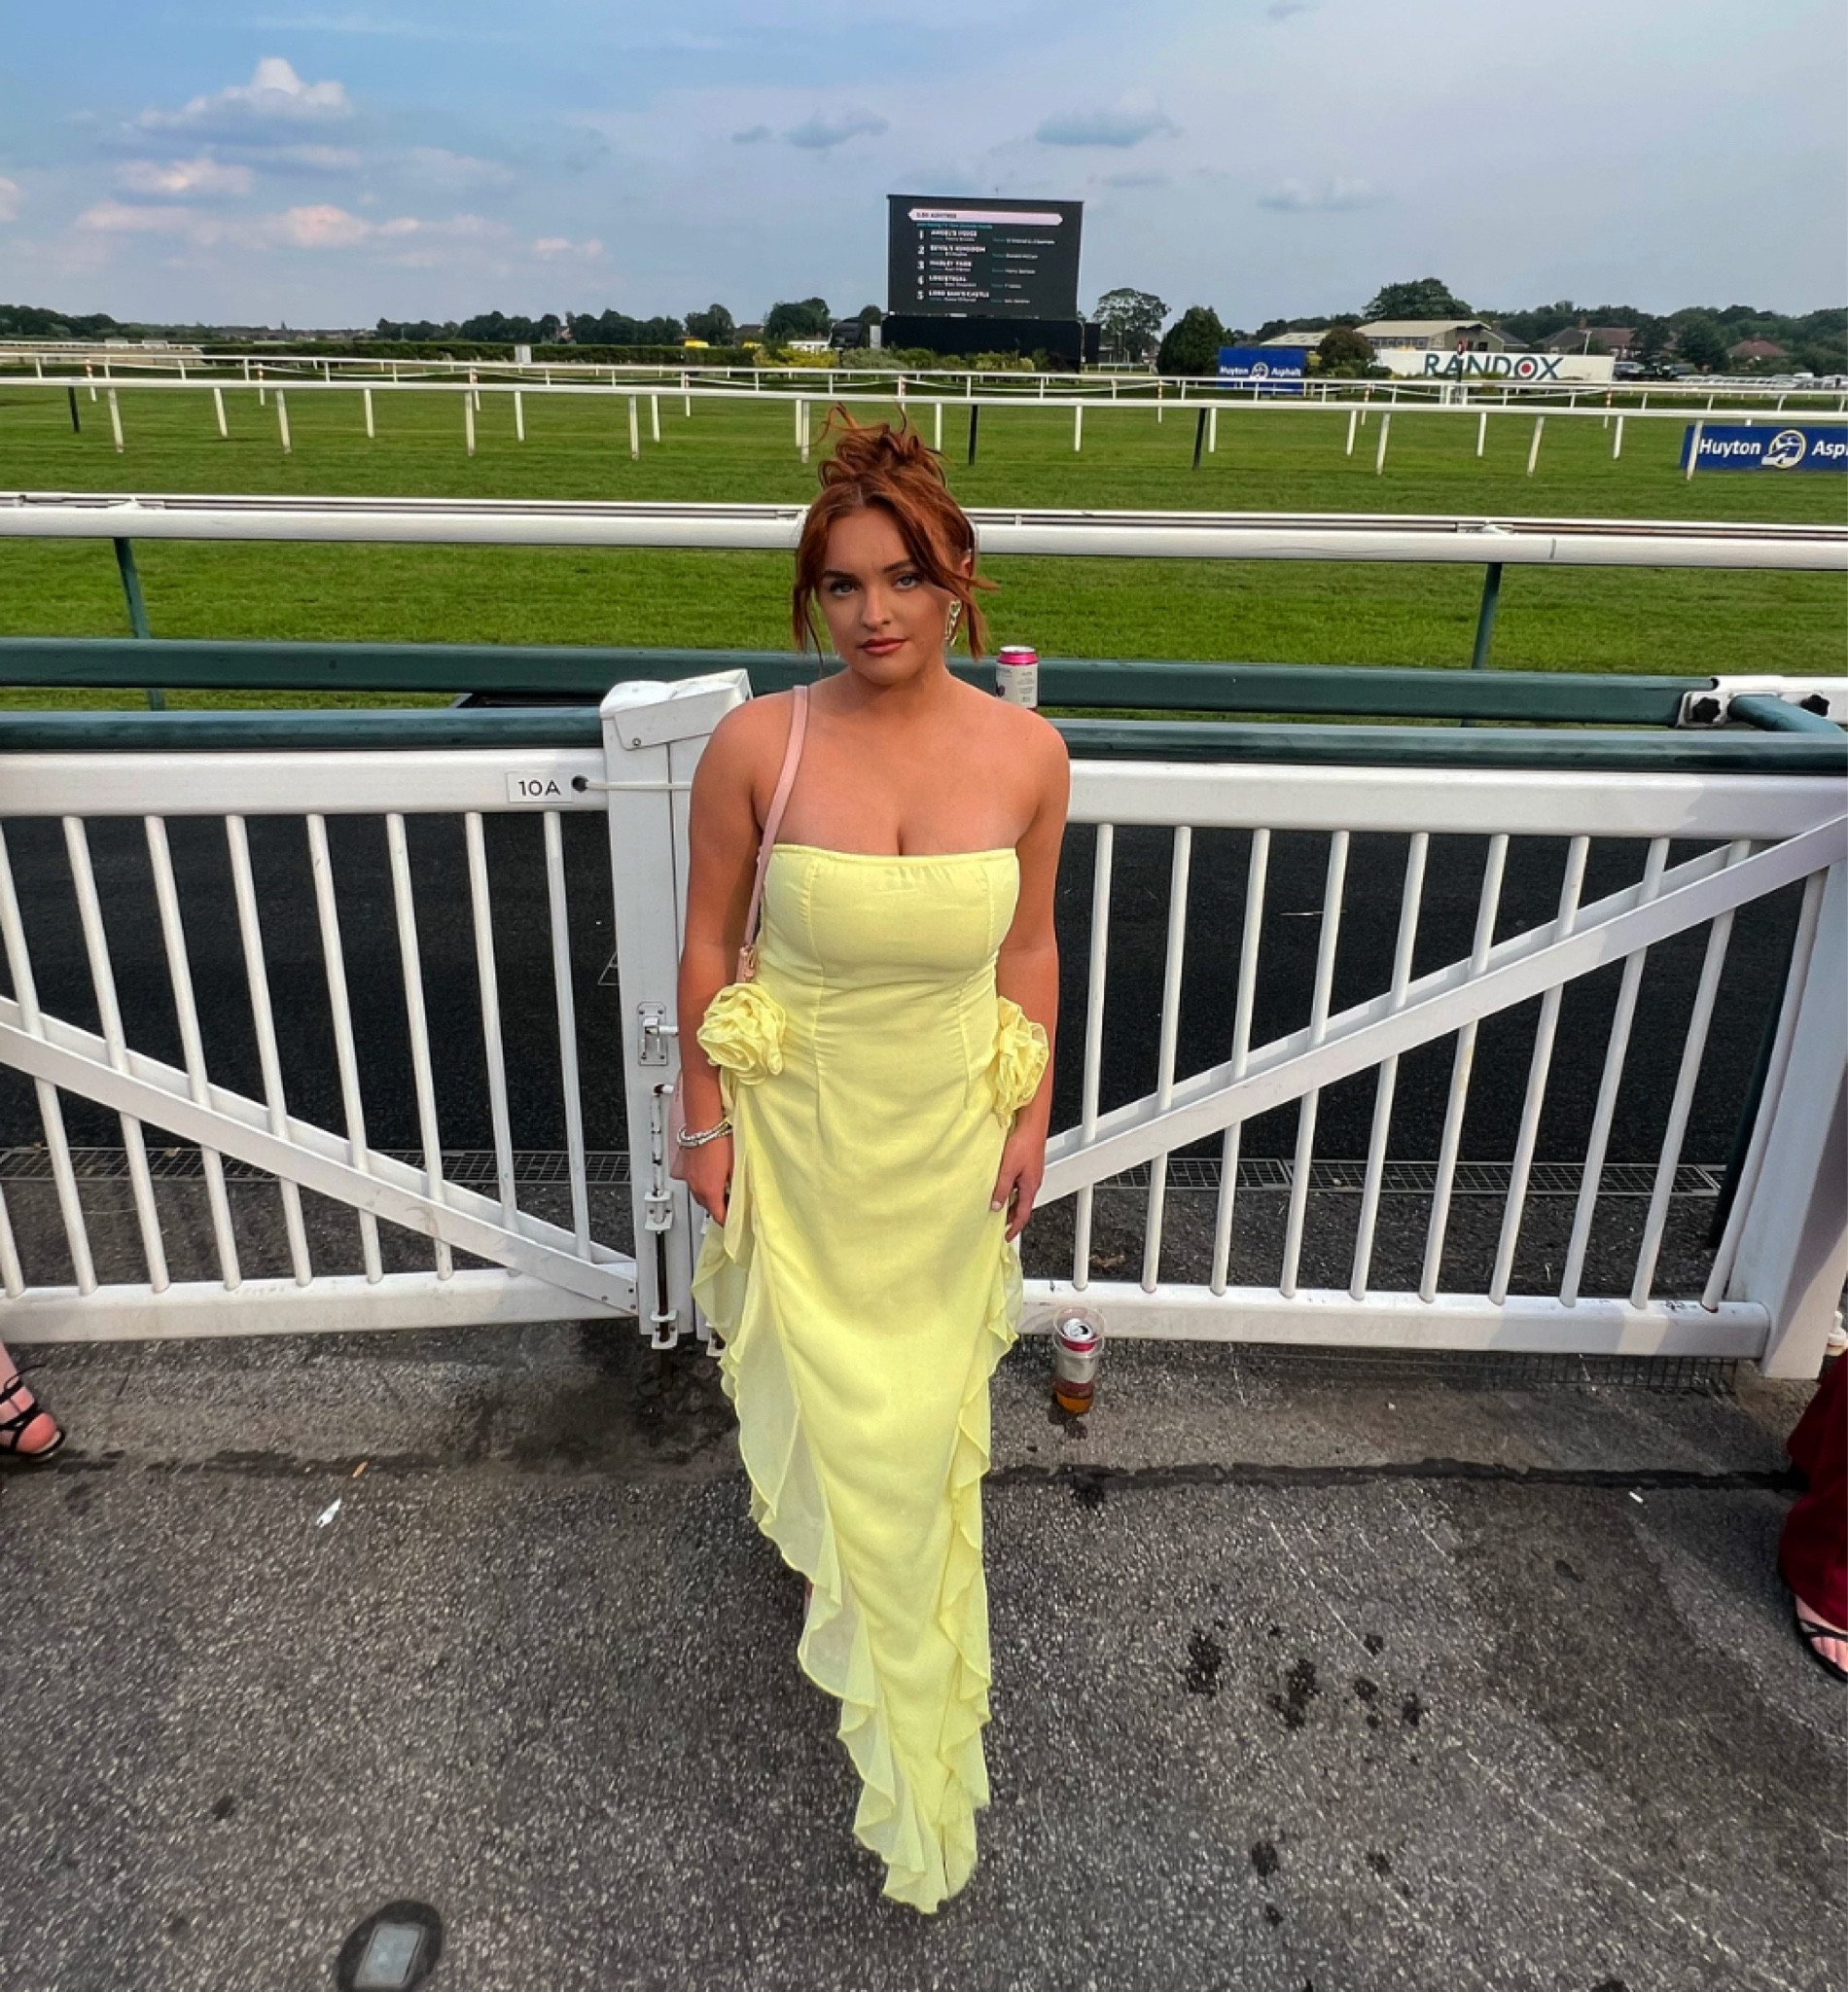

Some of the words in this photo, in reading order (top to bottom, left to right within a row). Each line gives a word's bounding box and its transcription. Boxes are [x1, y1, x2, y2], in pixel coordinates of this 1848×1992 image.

[919, 230, 924, 240] 1
[917, 244, 925, 255] 2
[916, 260, 925, 270] 3
[916, 274, 925, 285] 4
[916, 290, 925, 301] 5
[1220, 366, 1249, 376] Huyton
[1271, 367, 1301, 377] Asphalt
[1425, 352, 1563, 380] RANDOX
[1699, 437, 1761, 458] Huyton
[1811, 440, 1848, 459] Asp
[517, 779, 561, 797] 10A
